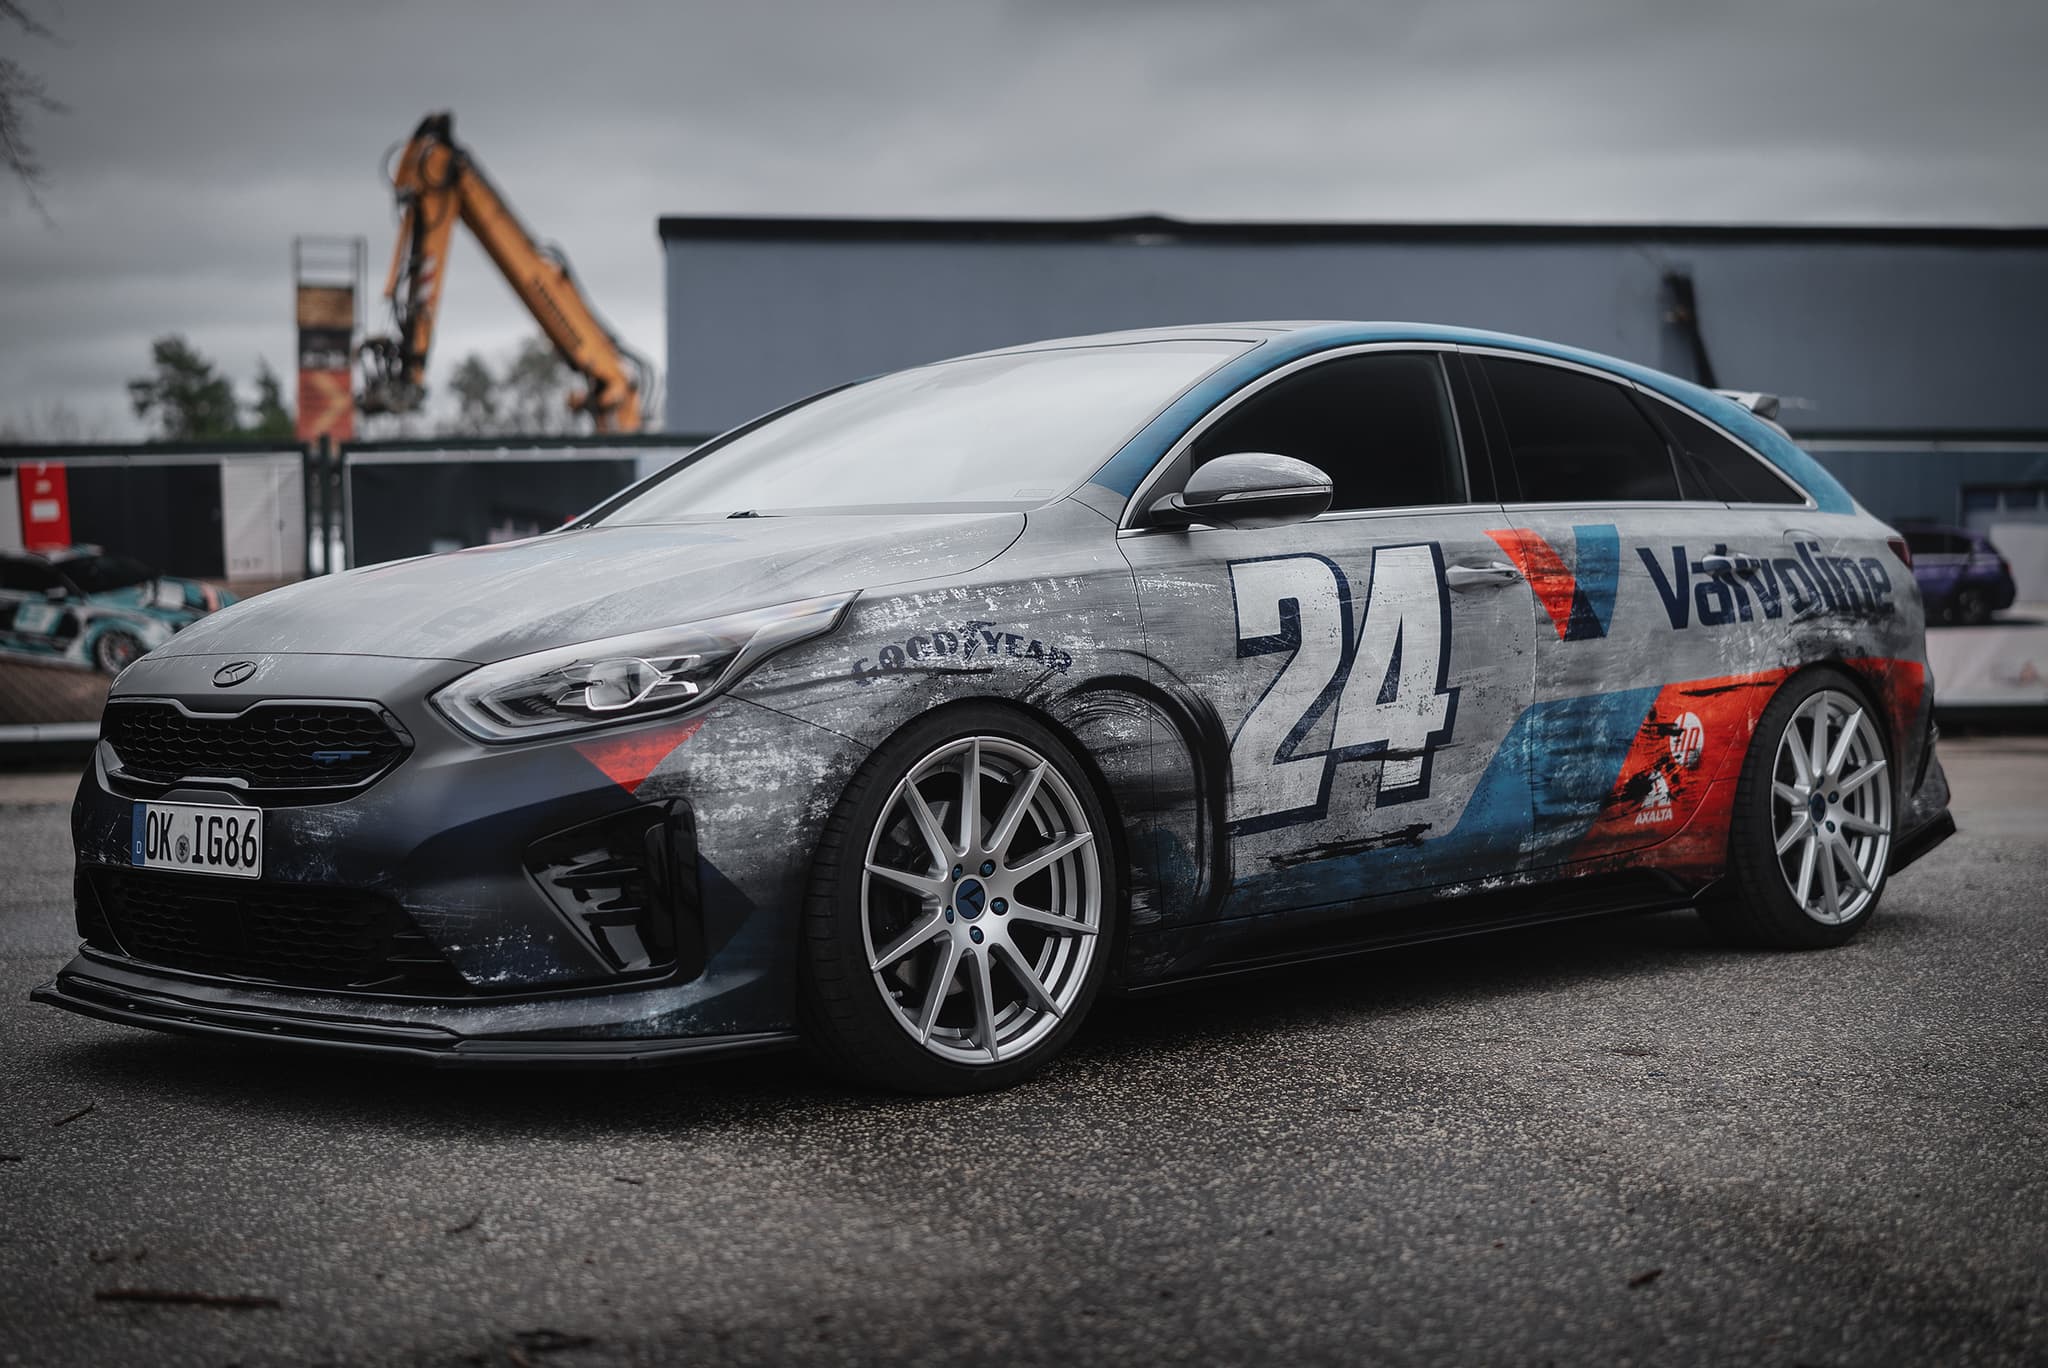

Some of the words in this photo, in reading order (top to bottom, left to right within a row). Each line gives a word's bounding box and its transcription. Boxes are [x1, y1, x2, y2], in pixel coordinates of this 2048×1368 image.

[1635, 542, 1896, 630] Valvoline
[1226, 541, 1460, 836] 24
[136, 841, 142, 854] D
[146, 811, 174, 861] OK
[192, 815, 257, 868] IG86
[1635, 808, 1673, 825] AXALTA
